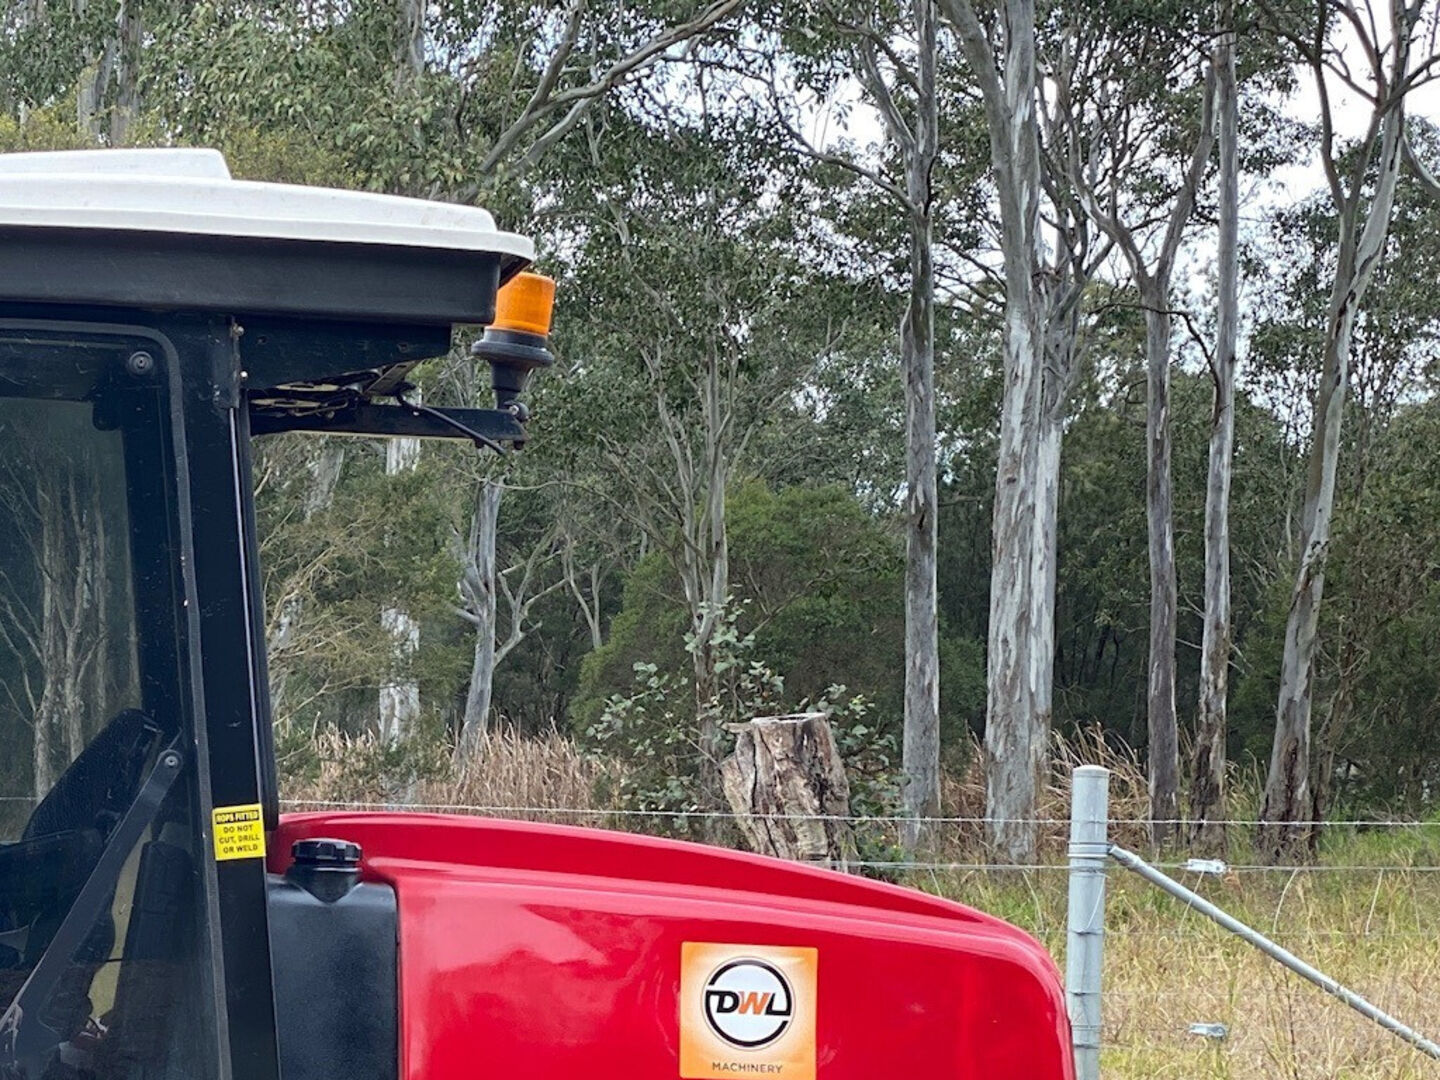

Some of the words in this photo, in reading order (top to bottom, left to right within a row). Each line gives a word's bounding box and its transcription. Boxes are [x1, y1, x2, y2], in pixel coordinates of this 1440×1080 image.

[223, 826, 235, 834] DO
[237, 824, 254, 832] NOT
[239, 834, 261, 842] DRILL
[223, 846, 235, 854] OR
[236, 844, 259, 852] WELD
[705, 990, 791, 1017] DWL
[712, 1062, 783, 1074] MACHINERY
